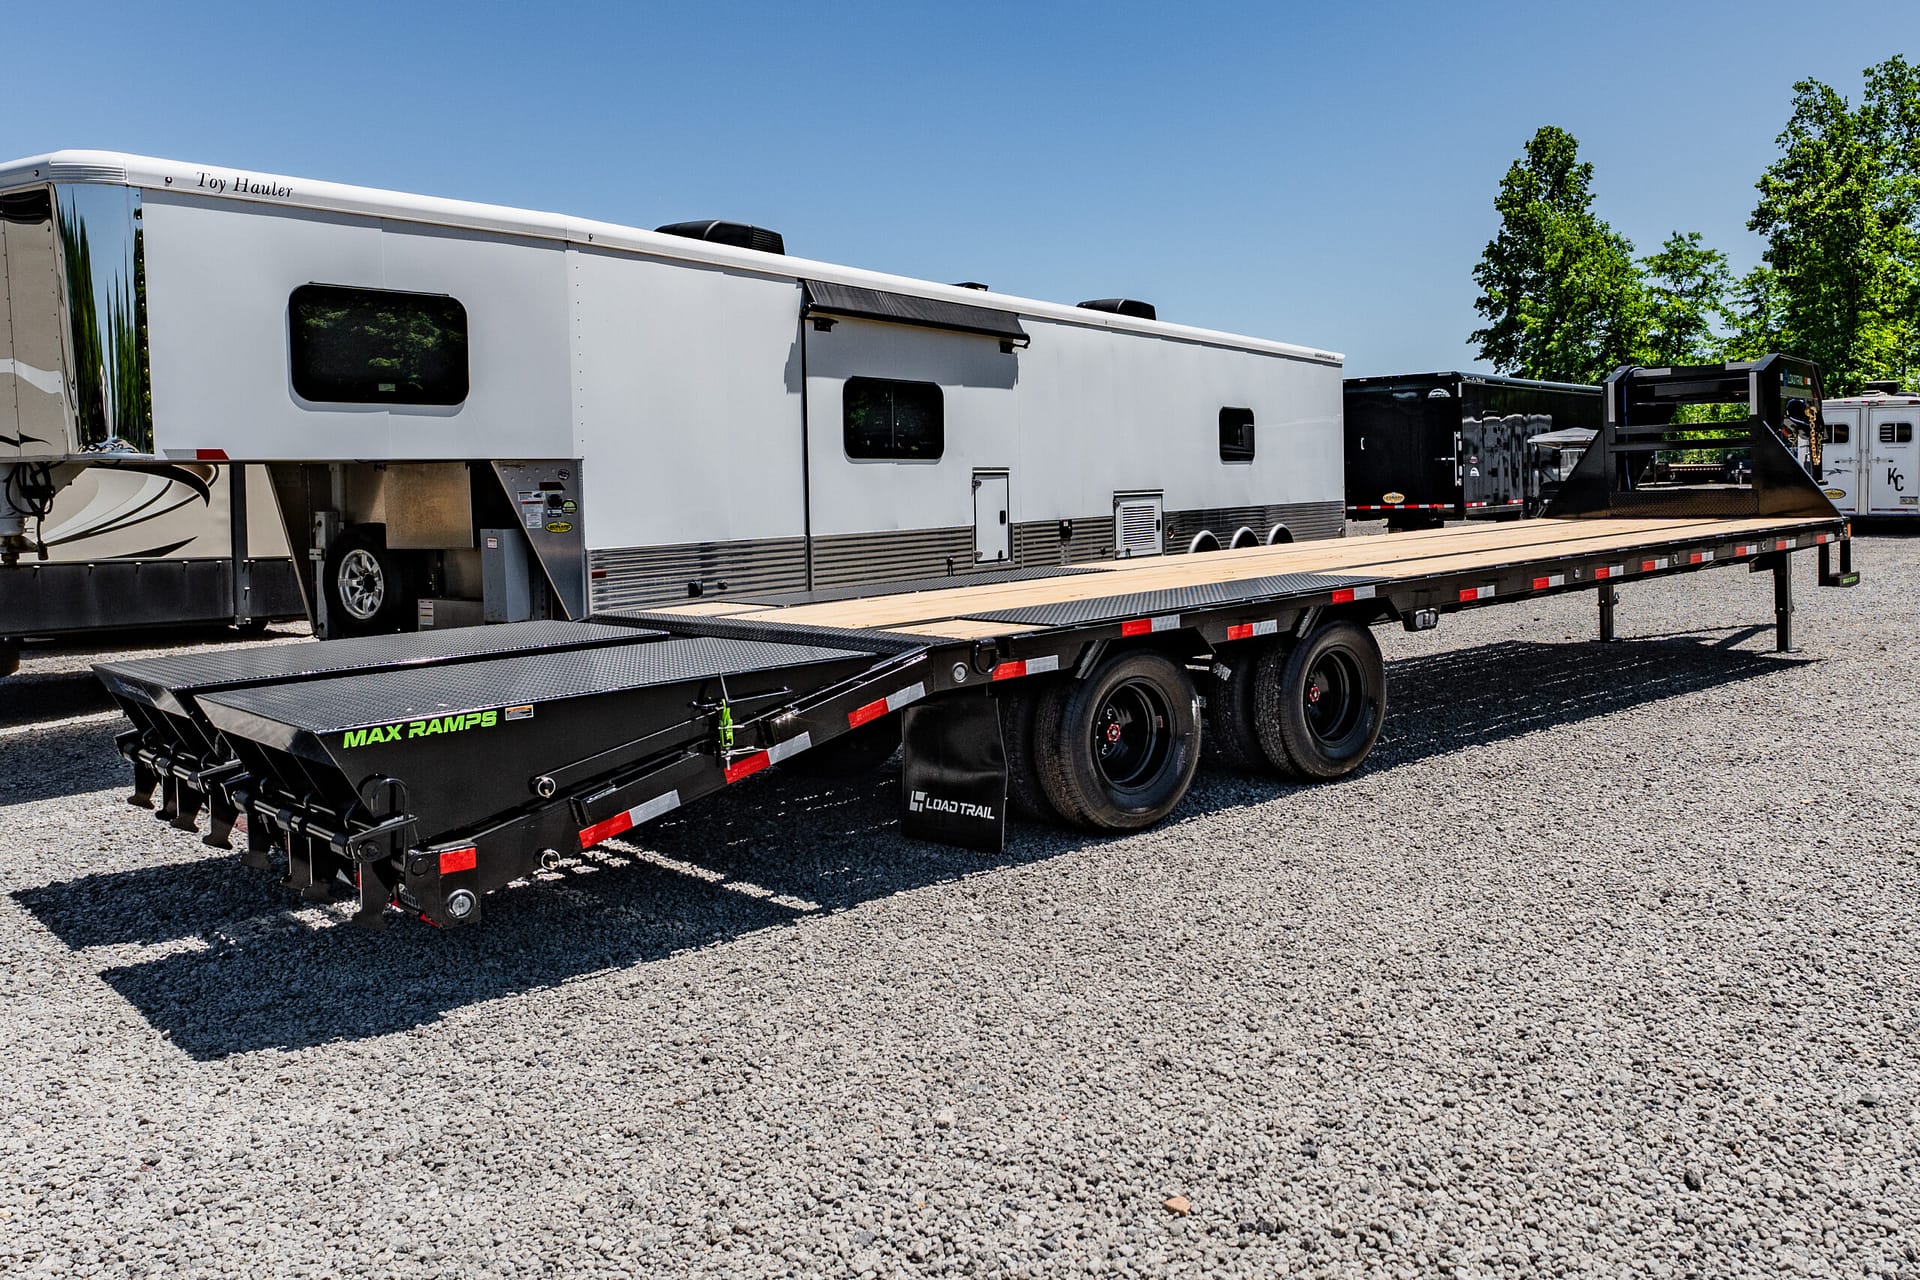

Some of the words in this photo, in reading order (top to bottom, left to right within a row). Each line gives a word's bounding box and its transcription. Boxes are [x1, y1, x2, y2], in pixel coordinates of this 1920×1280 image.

[196, 171, 226, 193] Toy
[233, 177, 293, 197] Hauler
[1887, 467, 1904, 491] KC
[343, 723, 403, 748] MAX
[408, 710, 498, 738] RAMPS
[925, 797, 958, 813] LOAD
[960, 802, 995, 820] TRAIL
